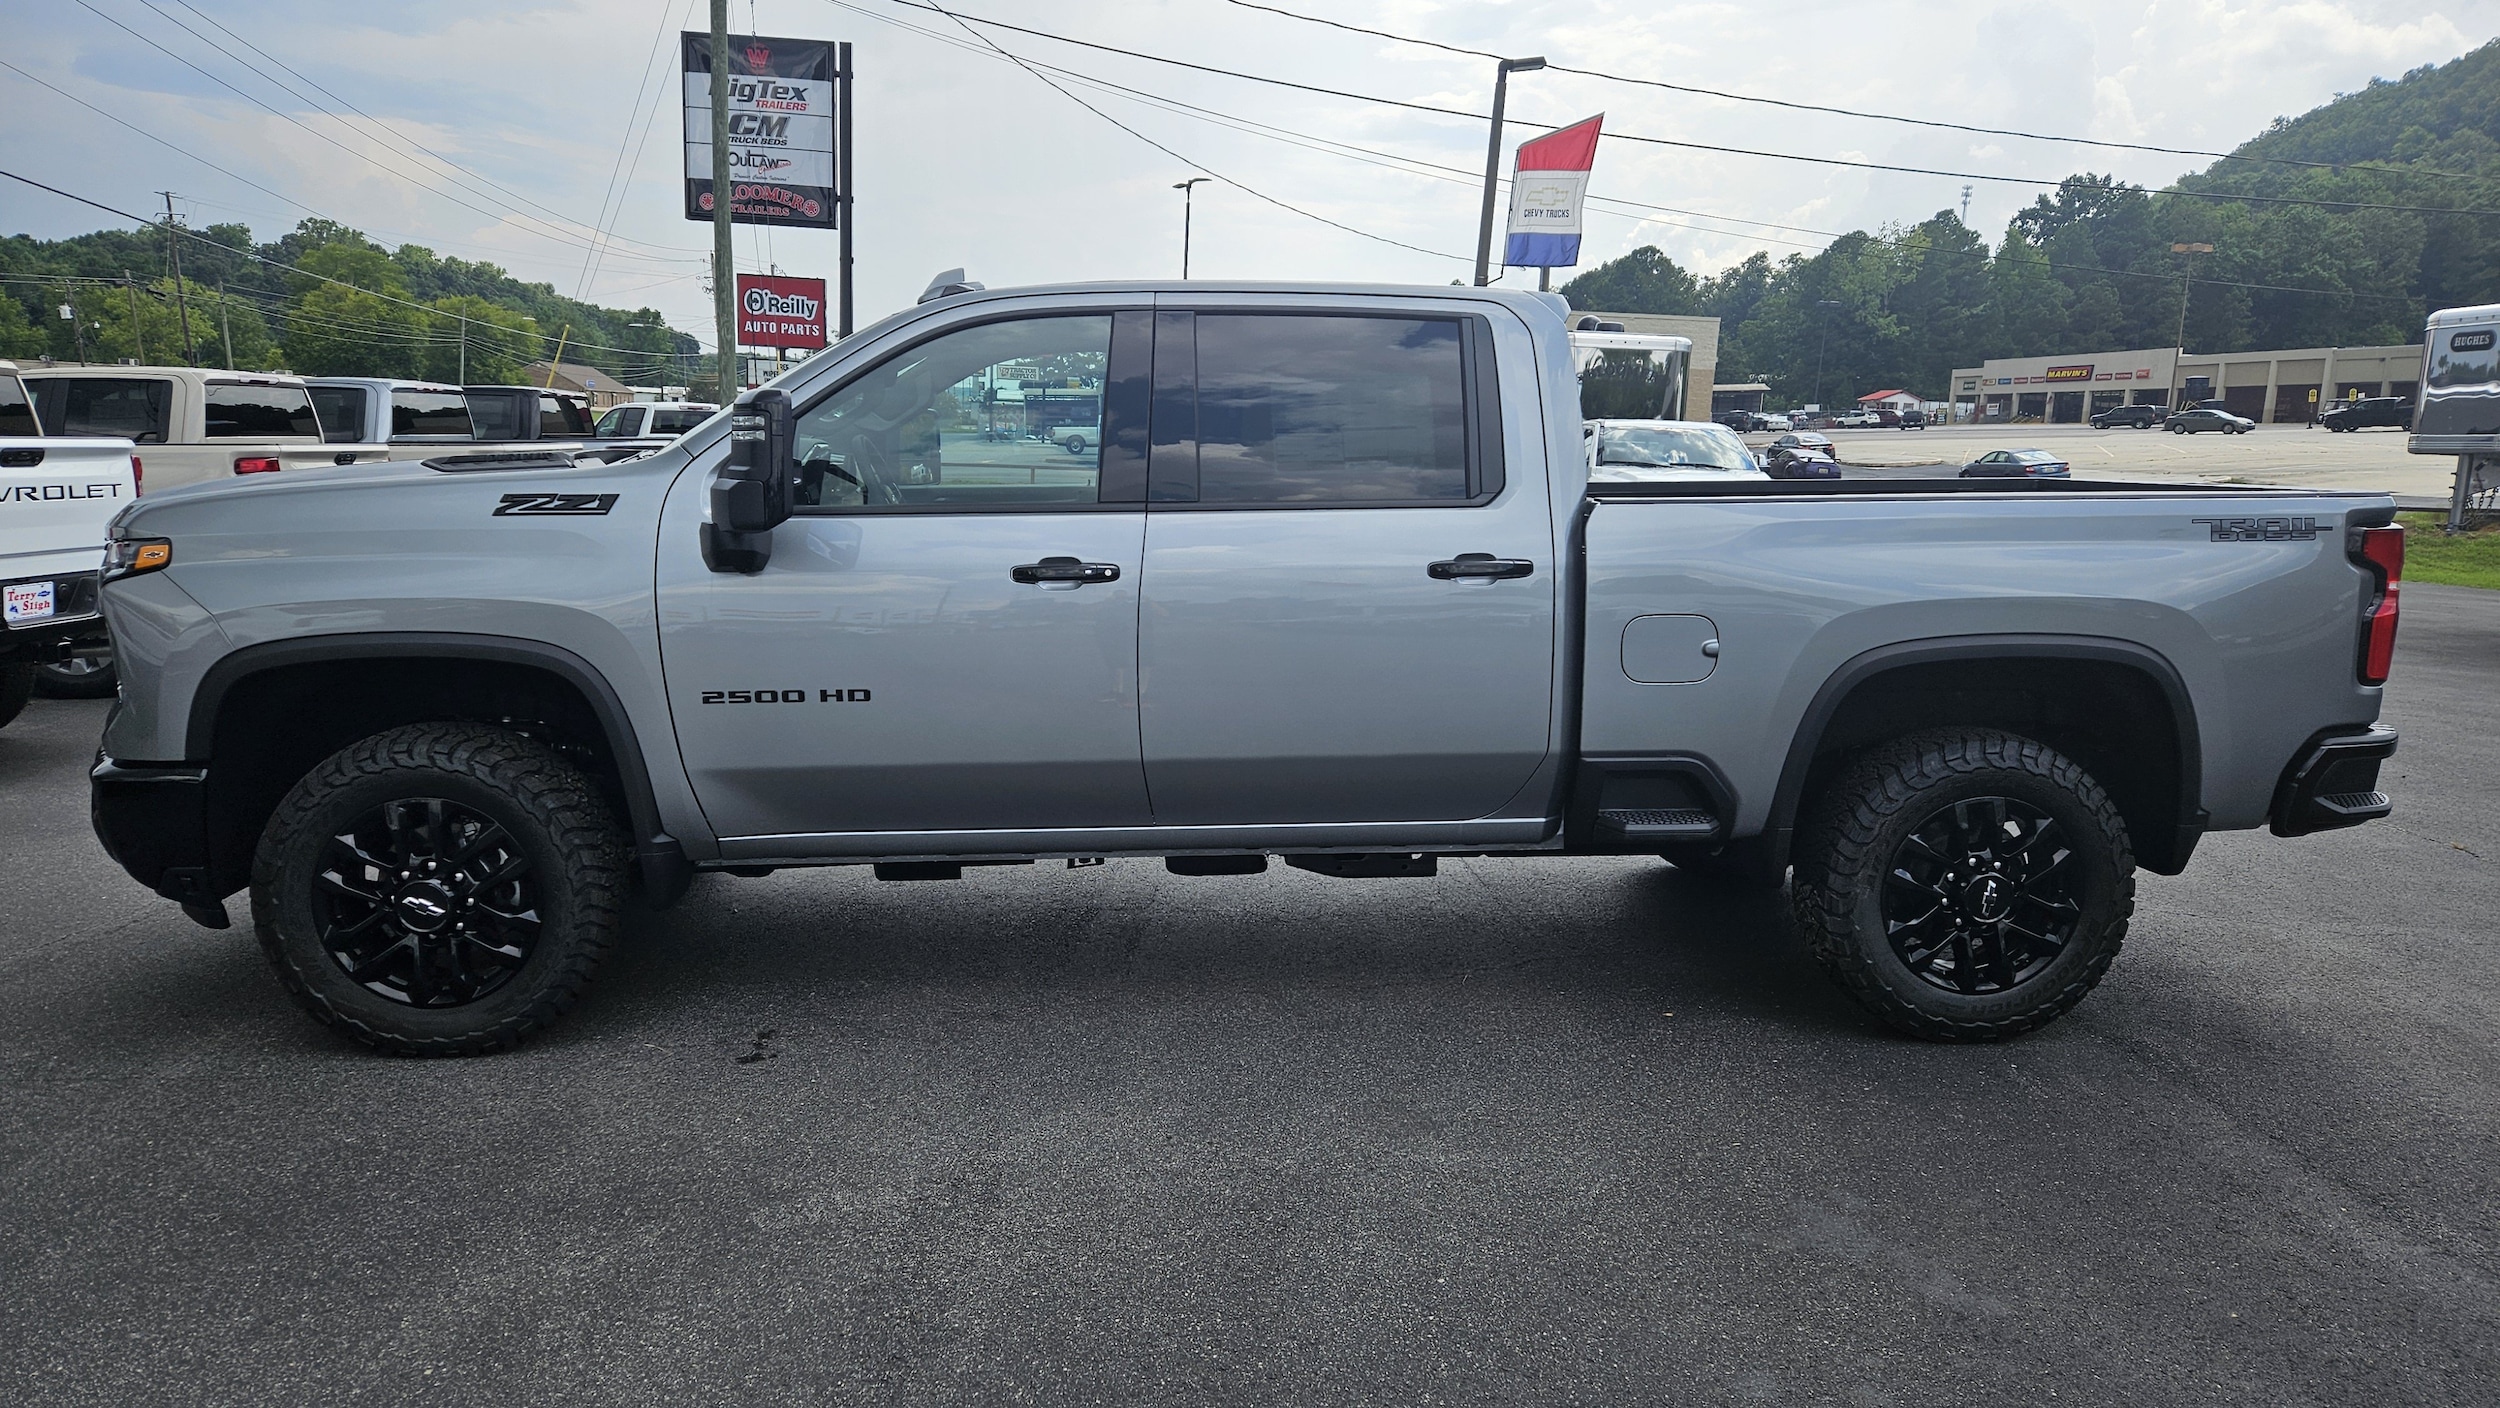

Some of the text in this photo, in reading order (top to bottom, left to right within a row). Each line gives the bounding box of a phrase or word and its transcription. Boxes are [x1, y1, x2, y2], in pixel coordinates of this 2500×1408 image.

[708, 78, 809, 102] igTex
[755, 100, 807, 111] TRAILERS
[729, 113, 790, 138] CM
[729, 136, 788, 146] TRUCK BEDS
[730, 184, 805, 212] OOMER
[730, 203, 790, 217] TRAILERS
[1523, 208, 1570, 218] CHEVY TRUCKS
[745, 289, 816, 319] O'Reilly
[744, 320, 820, 337] AUTO PARTS
[2453, 334, 2491, 347] HUGHES
[2047, 369, 2088, 378] MARVIN'S
[491, 493, 620, 516] Z71
[2210, 530, 2317, 542] BOSS
[7, 591, 37, 601] Terry
[22, 600, 50, 611] Sligh
[701, 689, 872, 704] 2500 HD
